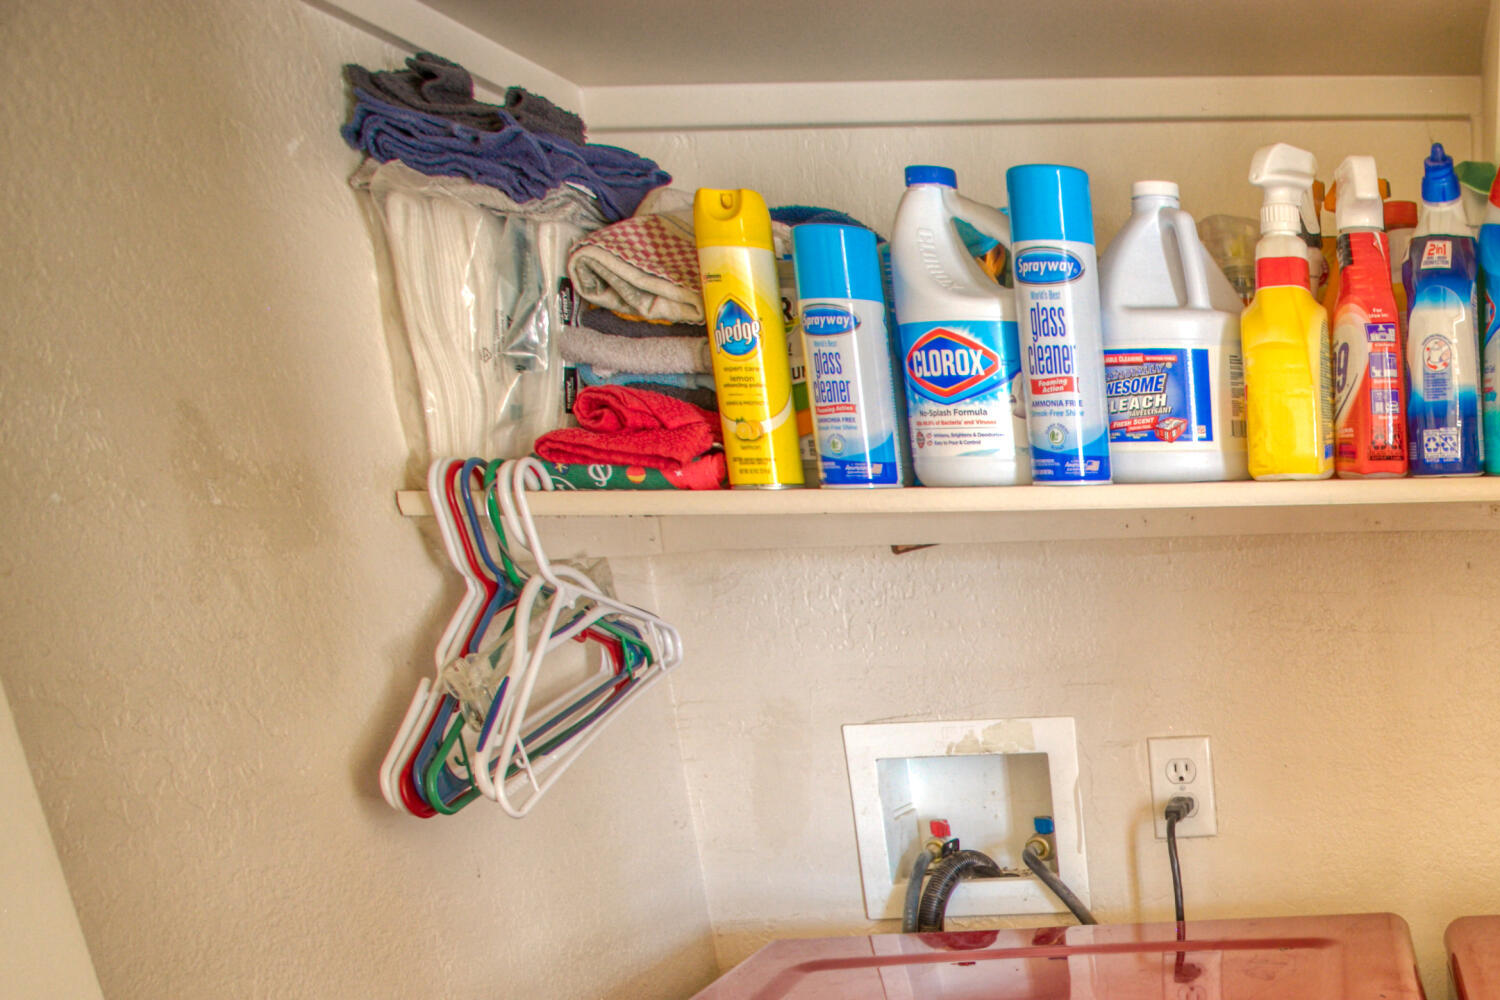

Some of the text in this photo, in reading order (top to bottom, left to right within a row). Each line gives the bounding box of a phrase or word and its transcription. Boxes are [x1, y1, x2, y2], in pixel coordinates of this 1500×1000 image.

[1427, 243, 1447, 256] 2in1
[1018, 258, 1074, 277] Sprayway
[1030, 302, 1067, 342] glass
[714, 318, 760, 354] pledge
[814, 349, 842, 378] glass
[912, 348, 985, 378] CLOROX
[1028, 343, 1076, 375] cleaner
[814, 380, 851, 403] cleaner
[1038, 378, 1067, 387] Foaming
[1042, 385, 1065, 393] Action
[920, 408, 988, 417] No-Splash Formula
[1110, 394, 1167, 414] LEACH
[1113, 421, 1132, 429] FRESH
[1133, 417, 1155, 426] SCENT
